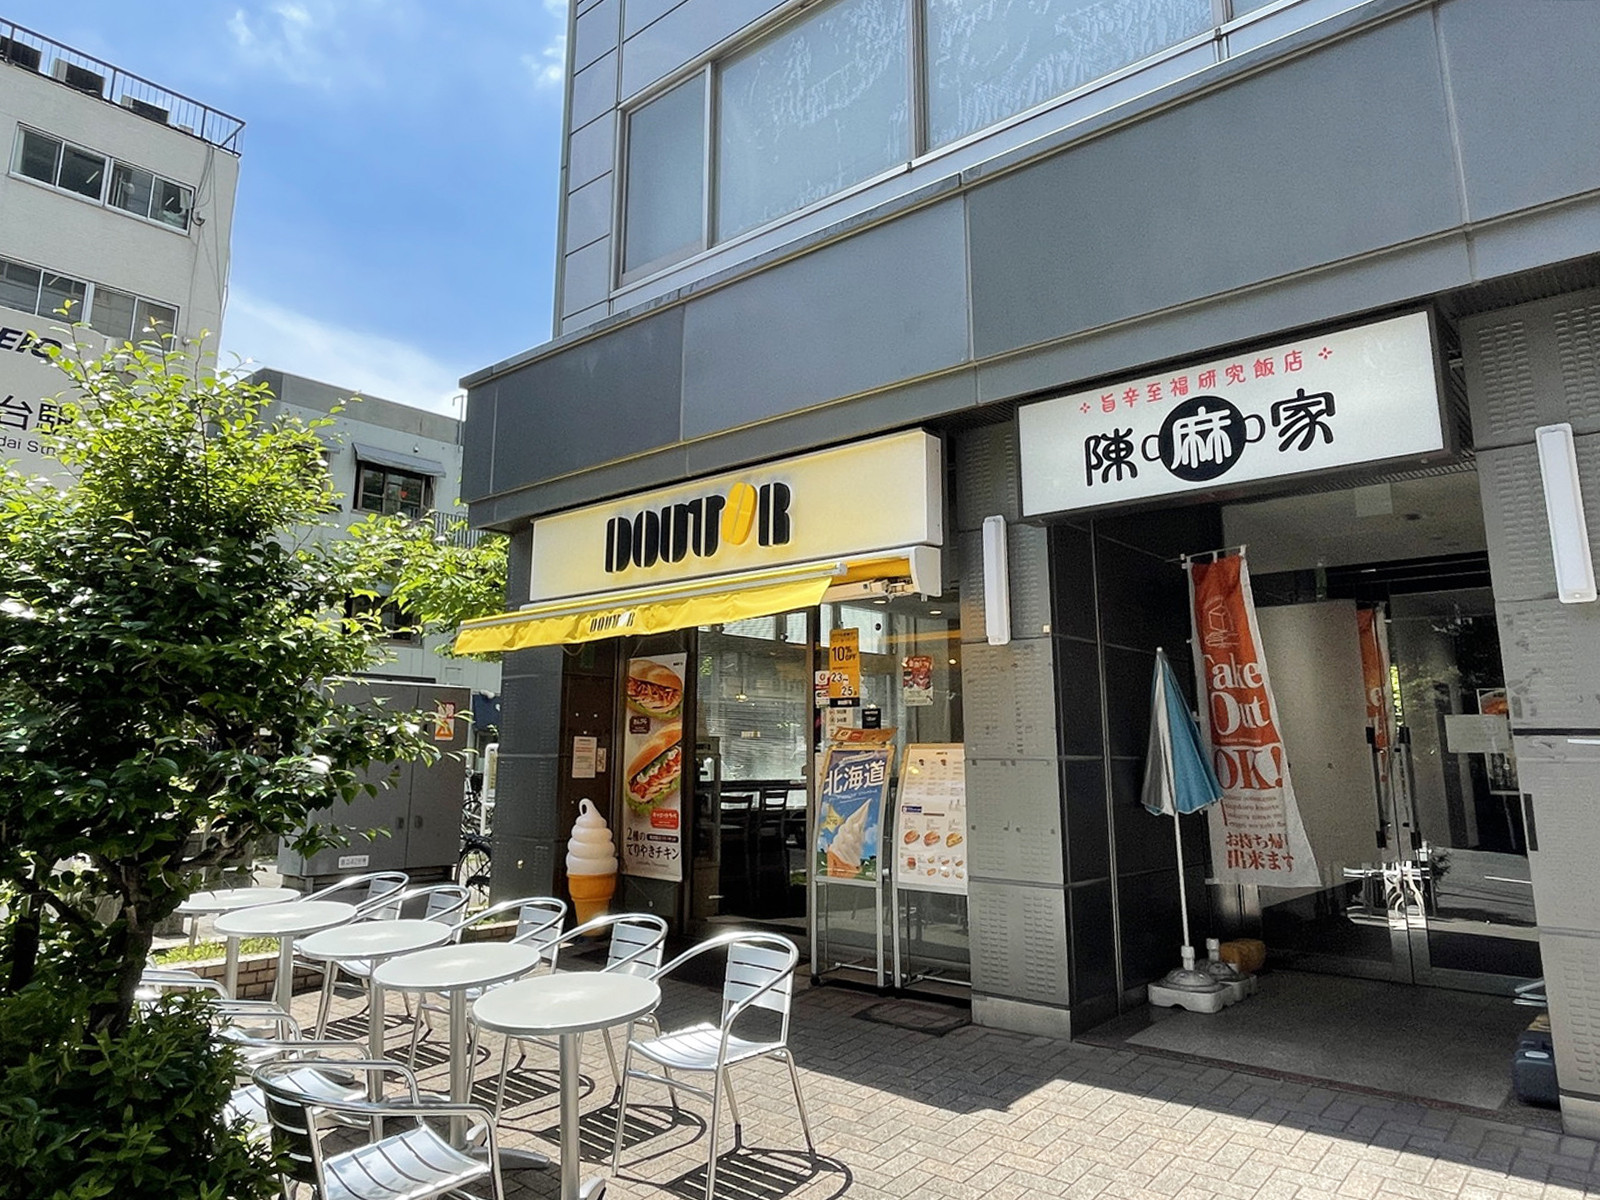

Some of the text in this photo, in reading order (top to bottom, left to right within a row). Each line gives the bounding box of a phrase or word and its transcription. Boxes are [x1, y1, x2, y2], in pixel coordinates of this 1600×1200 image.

[1100, 350, 1303, 413] 旨辛至福研究飯店
[1084, 388, 1336, 487] 陳麻家
[604, 481, 791, 573] DOUTOR
[590, 611, 636, 633] DOUTOR
[1204, 652, 1264, 690] ake
[823, 760, 886, 796] 北海道
[1214, 745, 1283, 790] OK!
[626, 843, 680, 861] てりやきチキン
